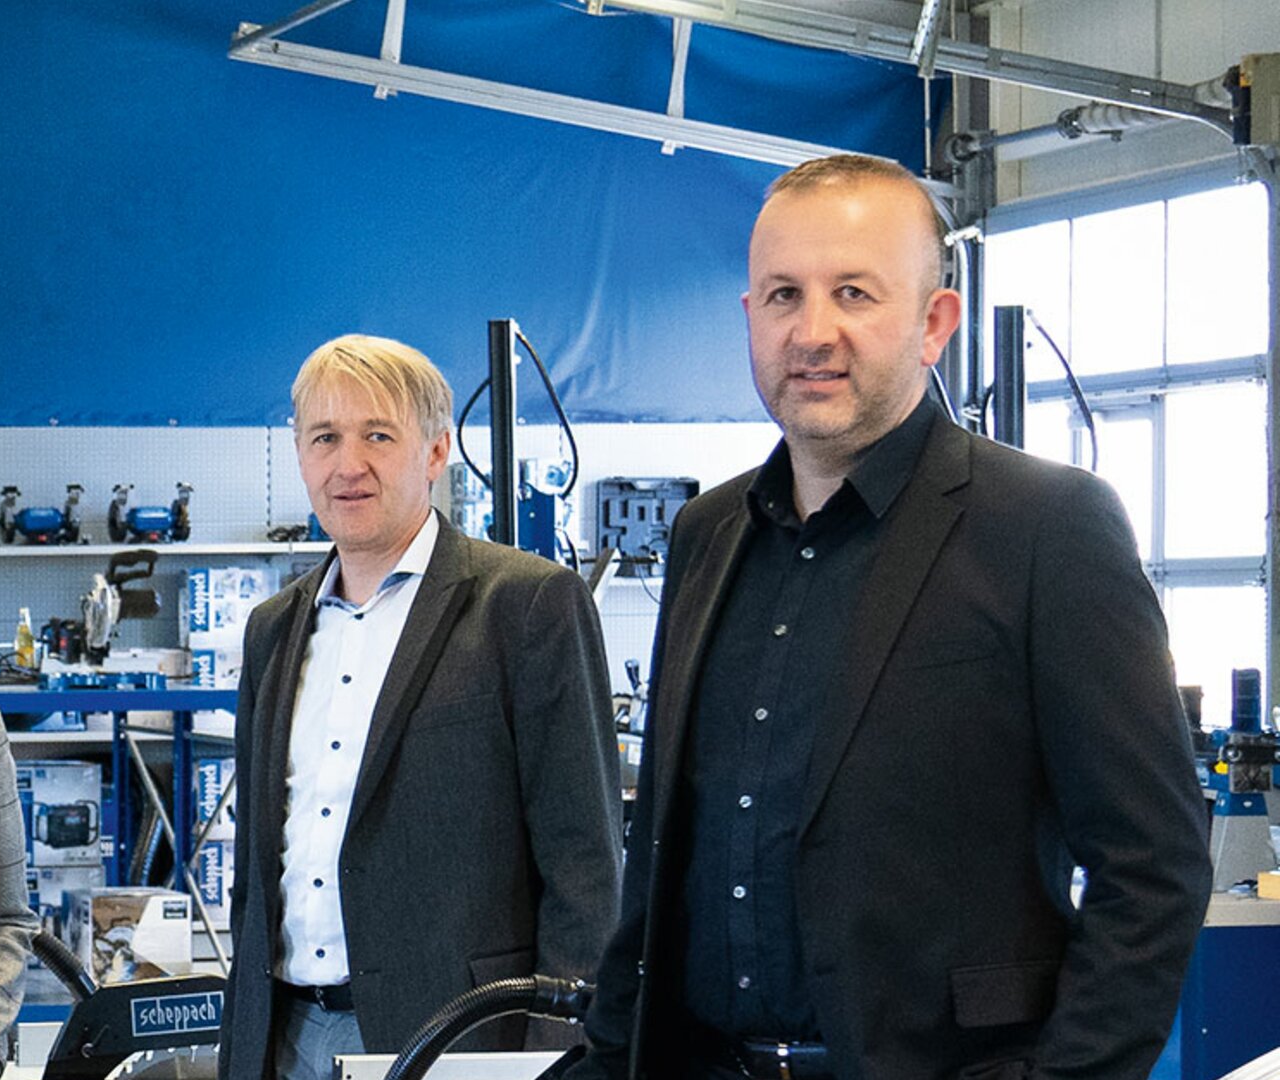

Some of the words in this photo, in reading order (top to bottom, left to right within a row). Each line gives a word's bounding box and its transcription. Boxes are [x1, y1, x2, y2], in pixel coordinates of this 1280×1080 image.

[188, 572, 209, 626] scheppach
[200, 847, 222, 901] scheppach
[140, 995, 216, 1030] scheppach
